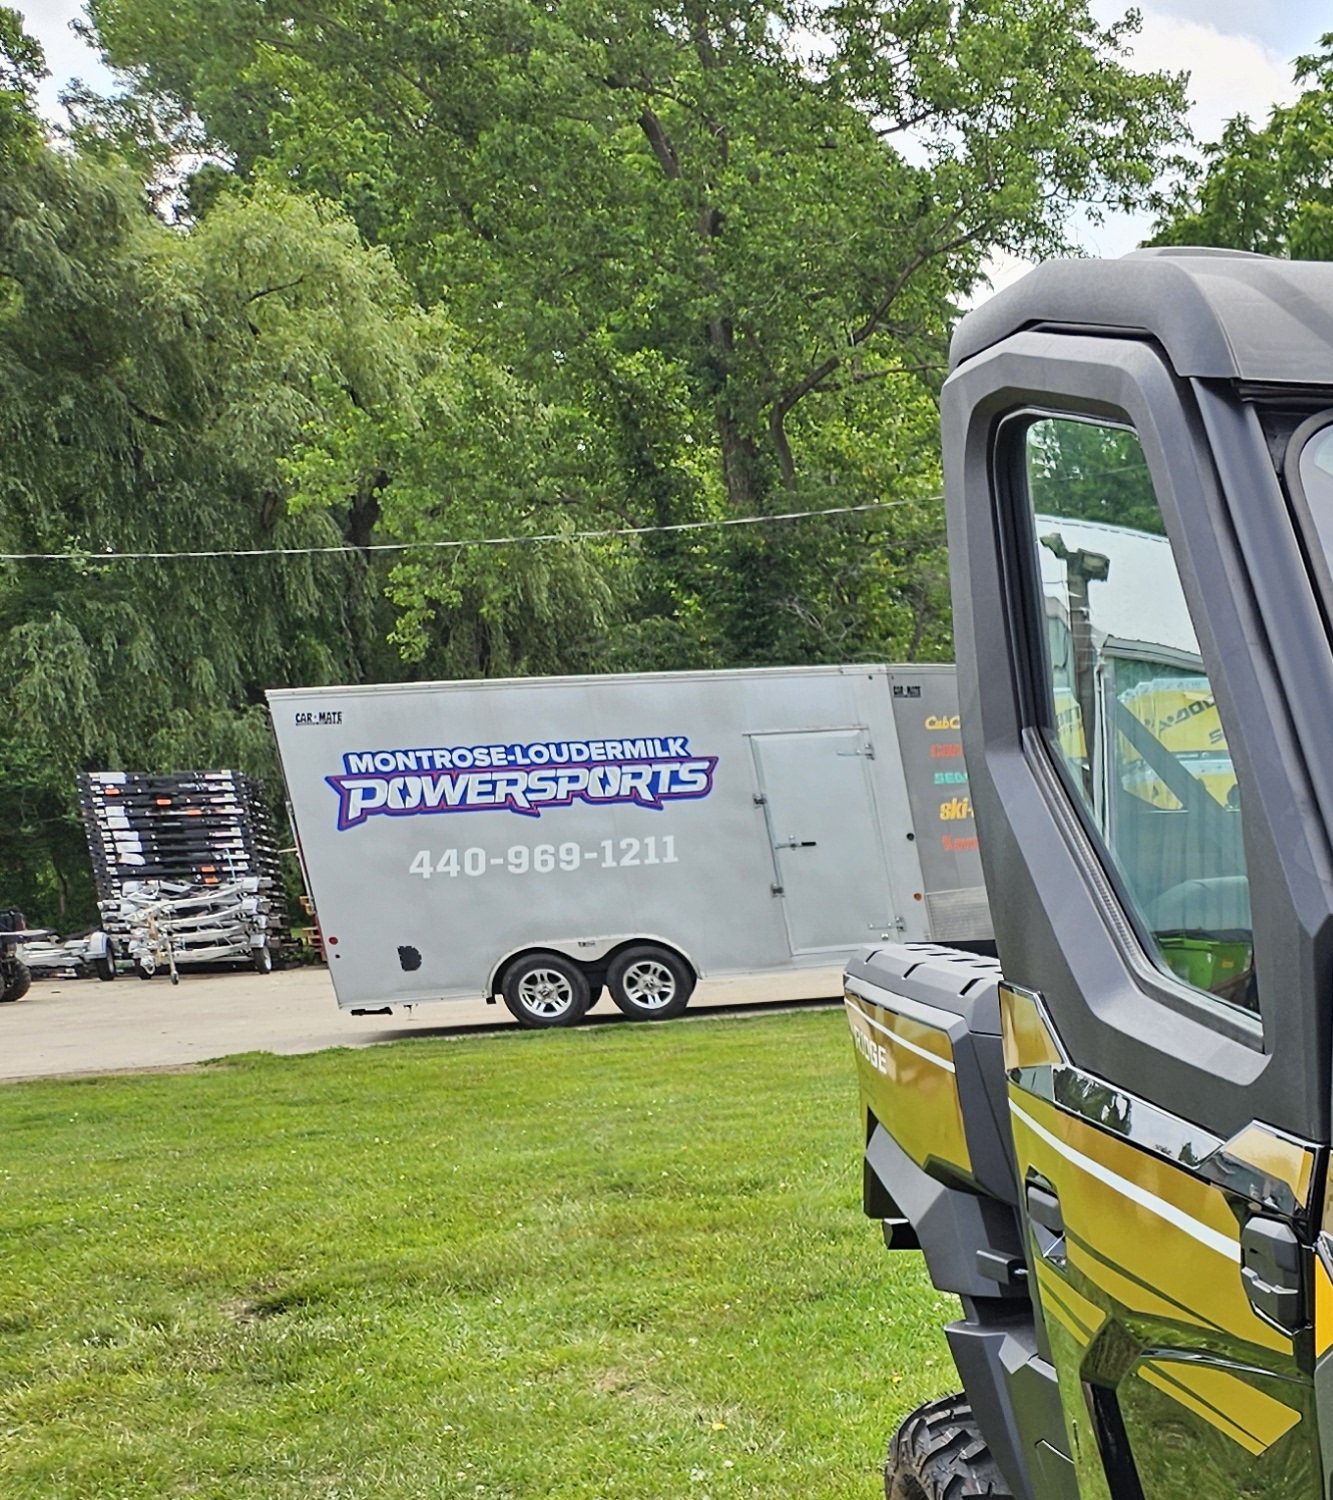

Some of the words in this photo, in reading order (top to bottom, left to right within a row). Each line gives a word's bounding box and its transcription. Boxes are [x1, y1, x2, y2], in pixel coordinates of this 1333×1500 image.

[349, 737, 689, 774] MONTROSE-LOUDERMILK
[340, 761, 711, 820] POWERSPORTS
[409, 835, 679, 879] 440-969-1211
